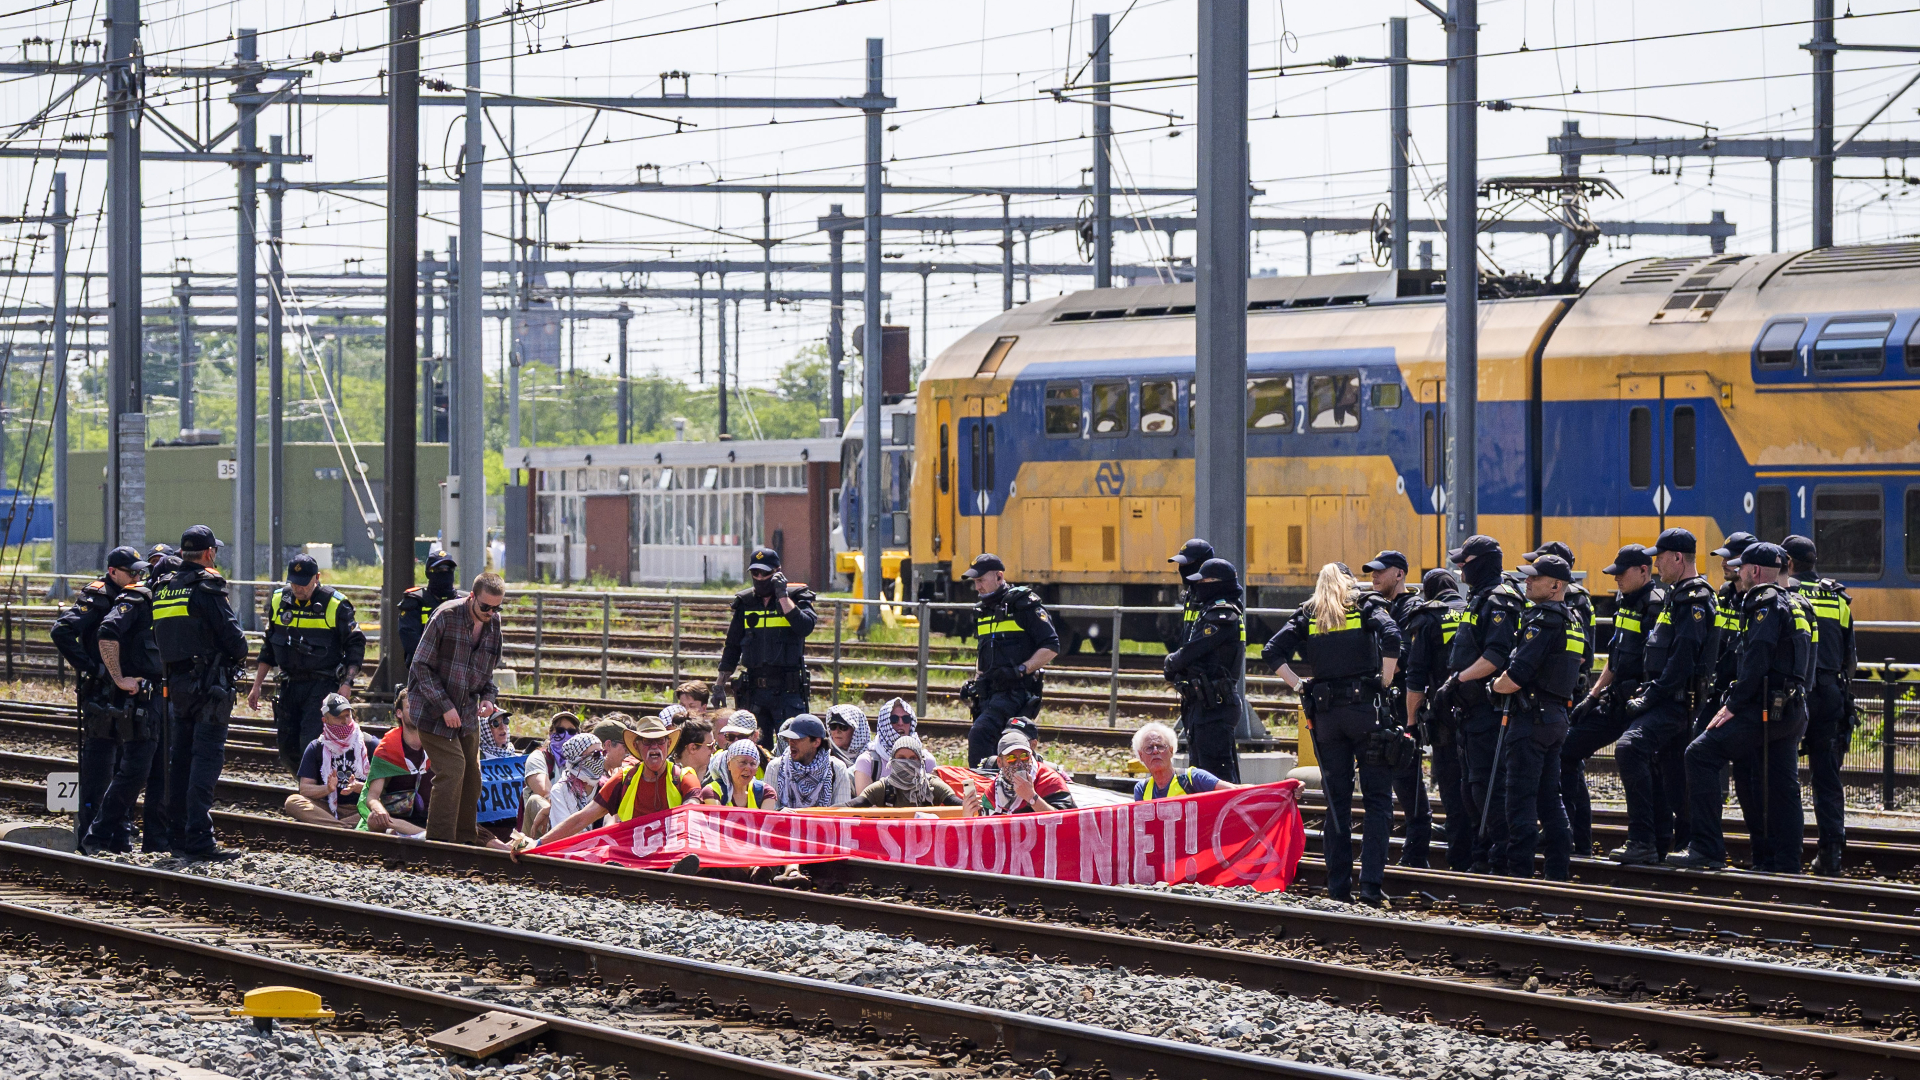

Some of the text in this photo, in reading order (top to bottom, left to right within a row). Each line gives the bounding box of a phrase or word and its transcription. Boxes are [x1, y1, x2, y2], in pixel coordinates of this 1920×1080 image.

[1800, 344, 1808, 377] 1
[1082, 411, 1090, 439] 2
[1297, 404, 1305, 434] 2
[221, 463, 236, 475] 35
[1797, 485, 1806, 518] 1
[481, 764, 514, 781] STOP
[57, 781, 78, 798] 27
[631, 801, 1198, 886] GENOCIDE SPOORT NIET!
